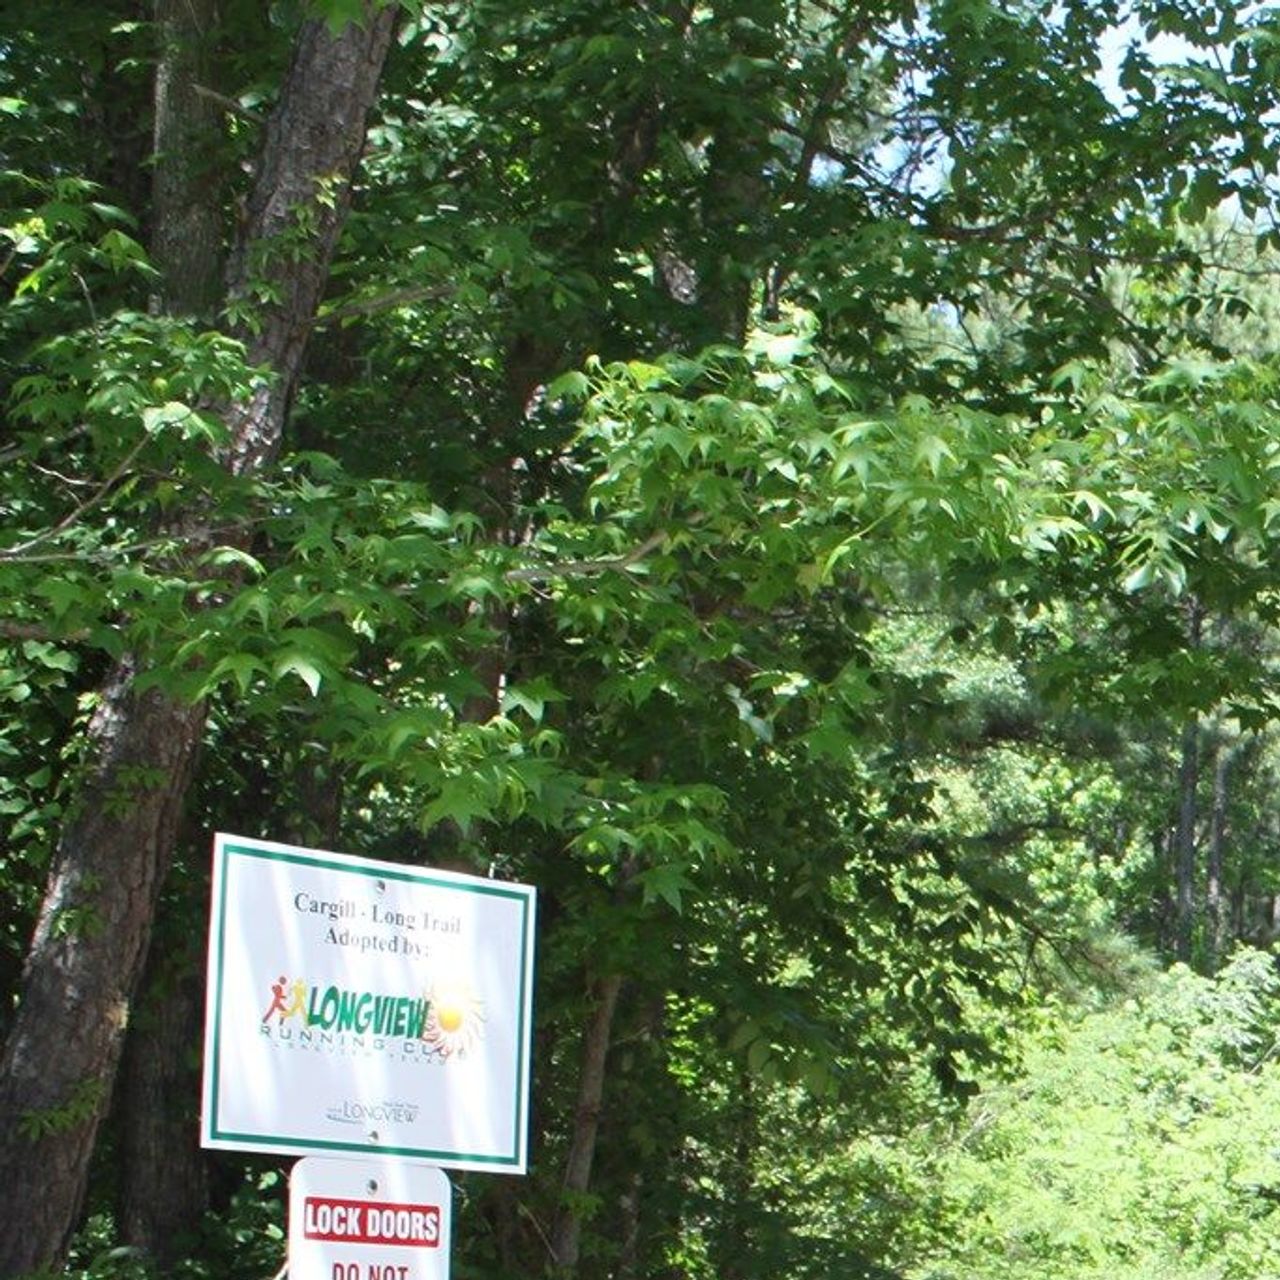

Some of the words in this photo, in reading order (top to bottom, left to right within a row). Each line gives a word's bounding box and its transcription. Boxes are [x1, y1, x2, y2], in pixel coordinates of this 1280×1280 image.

[294, 892, 356, 921] Cargill
[372, 904, 416, 930] Long
[423, 912, 462, 934] Trail
[325, 927, 398, 954] Adopted
[308, 986, 432, 1039] LONGVIEW
[260, 1025, 385, 1051] RUNNING
[344, 1101, 417, 1123] LONGVIEW
[306, 1203, 361, 1236] LOCK
[367, 1208, 438, 1241] DOORS
